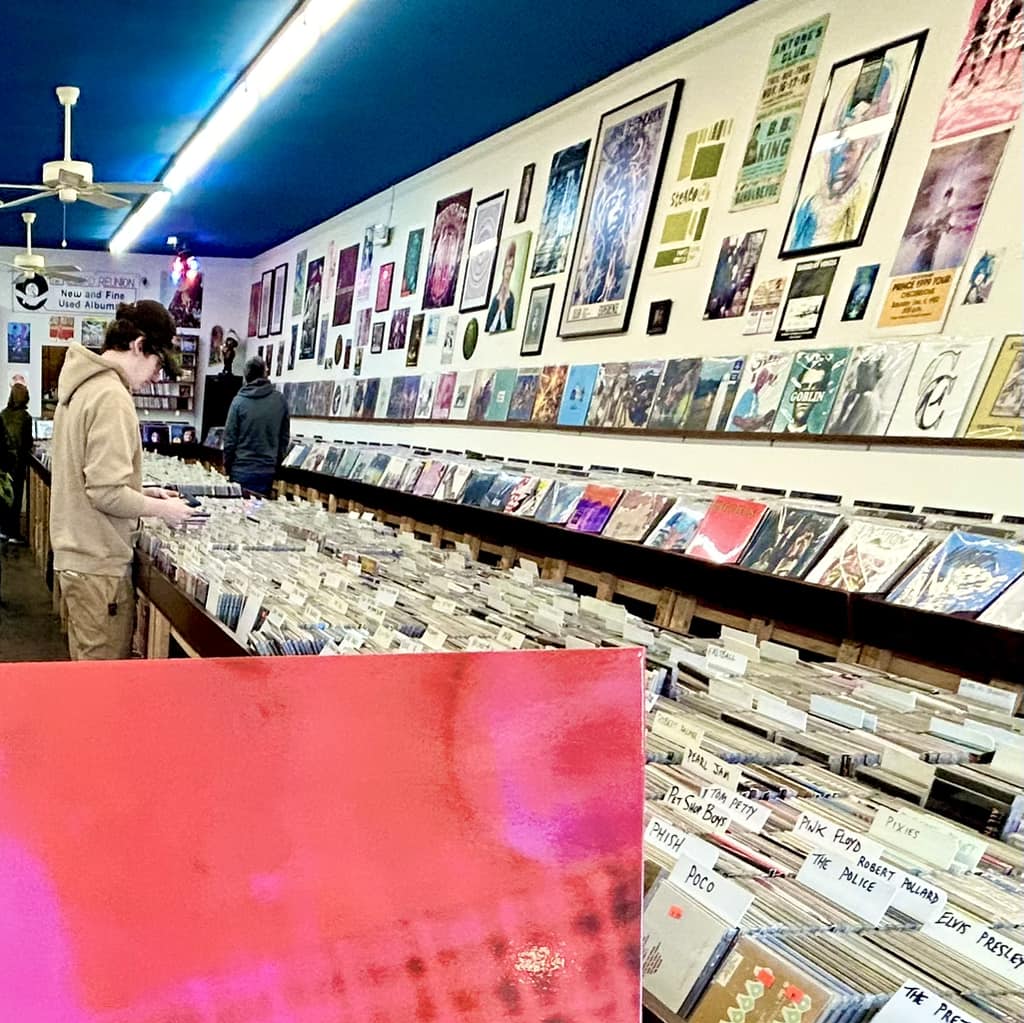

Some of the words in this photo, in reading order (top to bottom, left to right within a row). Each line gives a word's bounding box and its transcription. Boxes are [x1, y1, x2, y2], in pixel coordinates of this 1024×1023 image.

[781, 44, 808, 63] CLUB
[757, 137, 791, 162] KING
[98, 276, 135, 288] REUNION
[58, 300, 81, 309] Used
[85, 300, 115, 310] Album
[61, 290, 82, 298] New
[85, 291, 102, 299] and
[106, 291, 125, 300] Fine
[790, 391, 826, 402] GOBLIN
[688, 749, 708, 770] PEARL
[713, 762, 730, 780] JAM
[668, 785, 682, 806] PET
[711, 788, 727, 804] TOM
[729, 798, 757, 819] PETTY
[649, 822, 686, 853] PHISH
[799, 815, 828, 838] PINK
[833, 828, 862, 853] FLOYD
[885, 815, 920, 839] PIXIES
[684, 864, 715, 893] POCO
[812, 853, 832, 871] THE
[839, 866, 877, 893] POLICE
[857, 855, 896, 881] ROBERT
[901, 877, 940, 905] POLLARD
[935, 911, 972, 935] ELVIS
[976, 931, 1024, 969] PRESLEY
[903, 984, 929, 1006] THE
